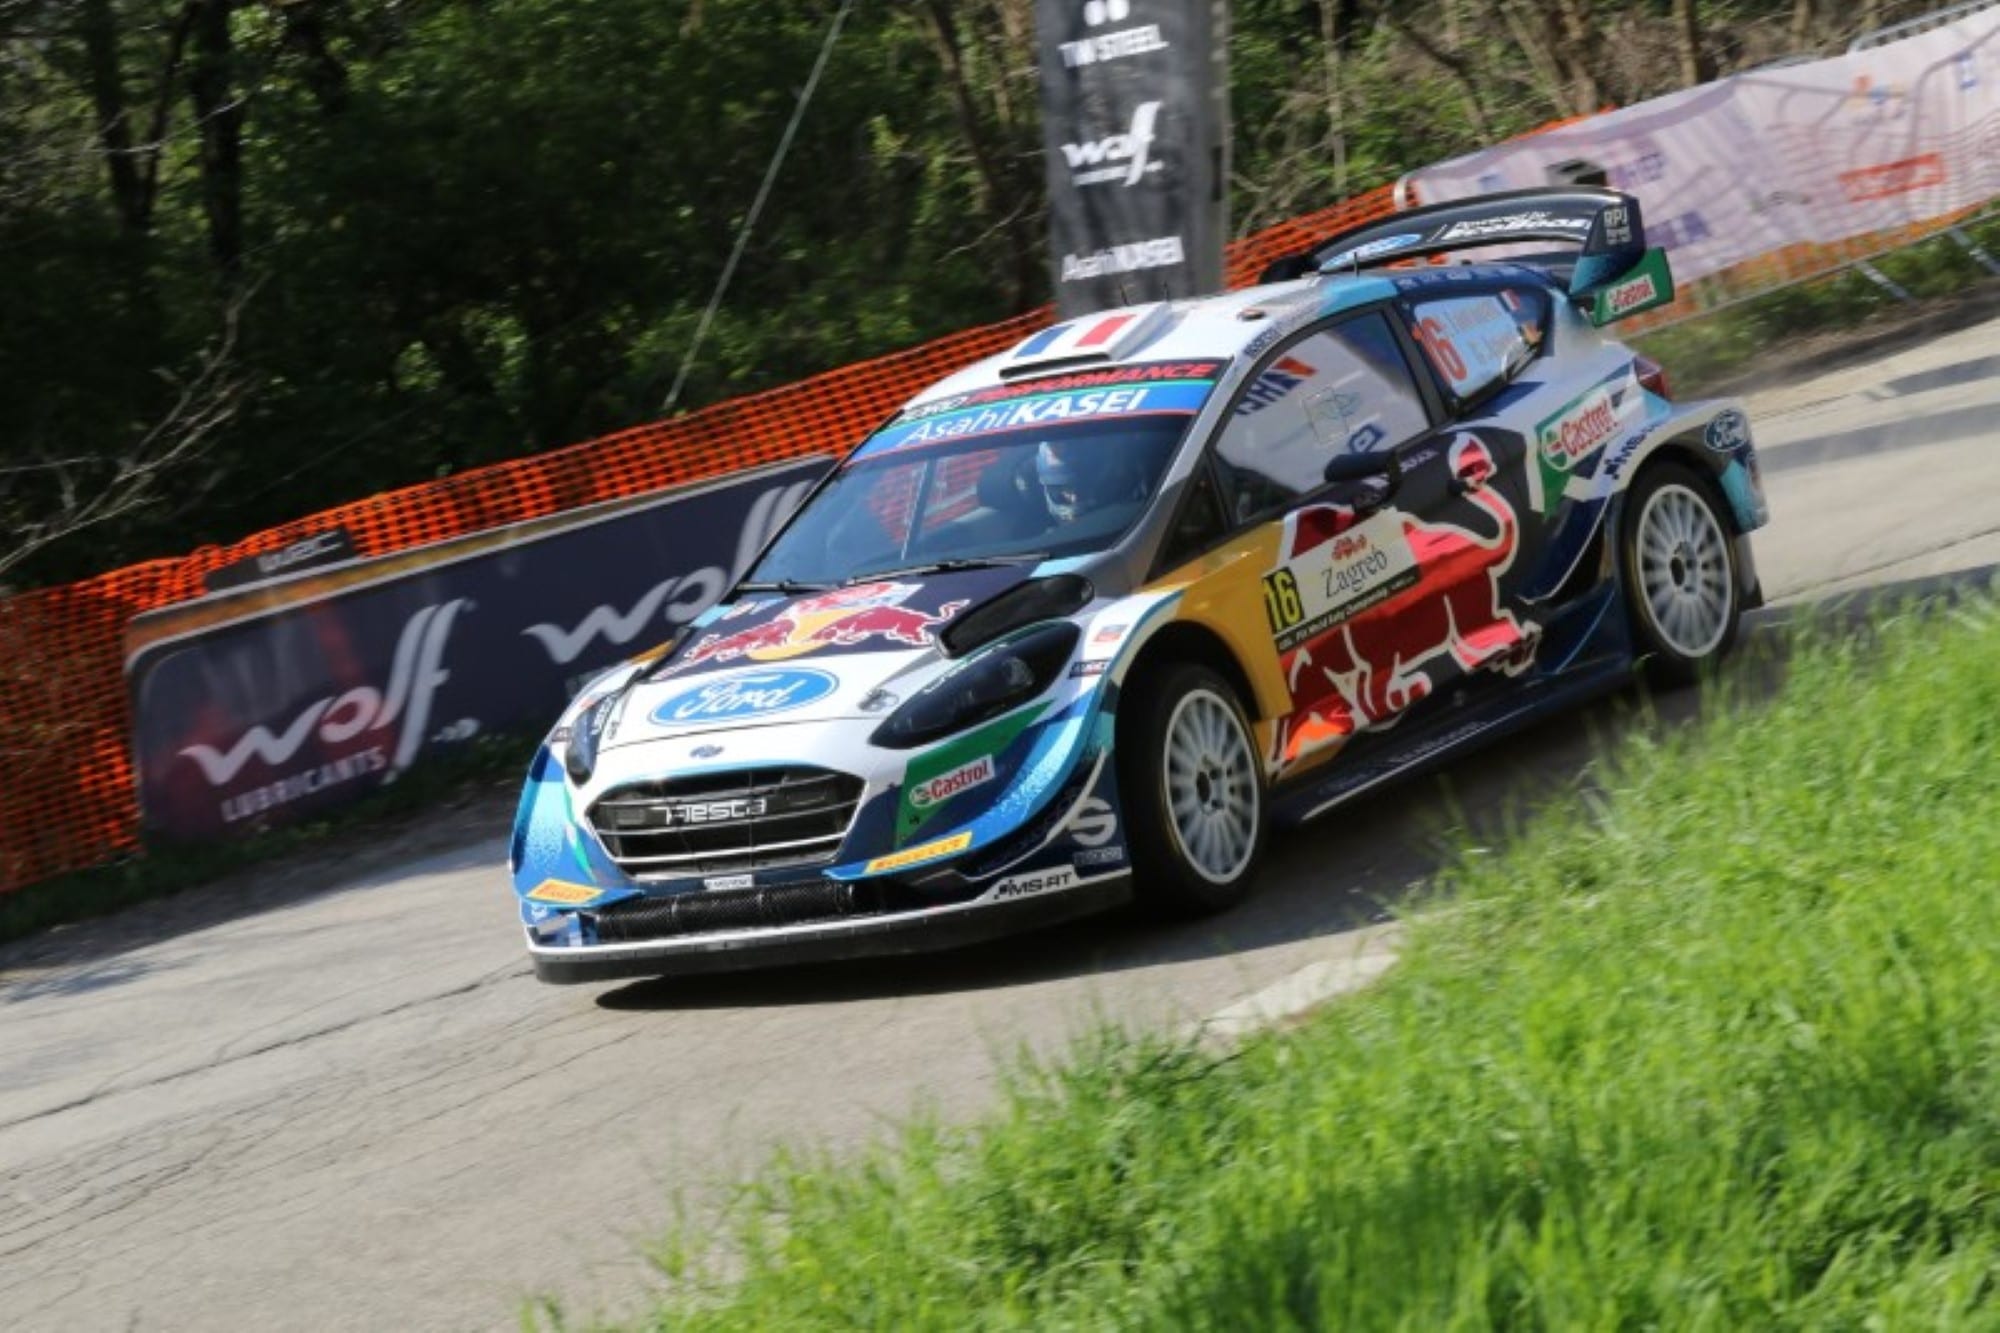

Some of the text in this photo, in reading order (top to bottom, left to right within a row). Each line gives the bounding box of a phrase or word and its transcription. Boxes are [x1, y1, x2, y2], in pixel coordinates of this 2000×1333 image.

[900, 389, 1149, 447] AsahiKASEI
[1561, 396, 1617, 457] Castrol
[1320, 544, 1388, 598] Zagreb
[1262, 570, 1301, 632] 16
[674, 671, 807, 721] Ford
[221, 746, 387, 823] LUBRICANTS
[931, 760, 989, 799] Castrol
